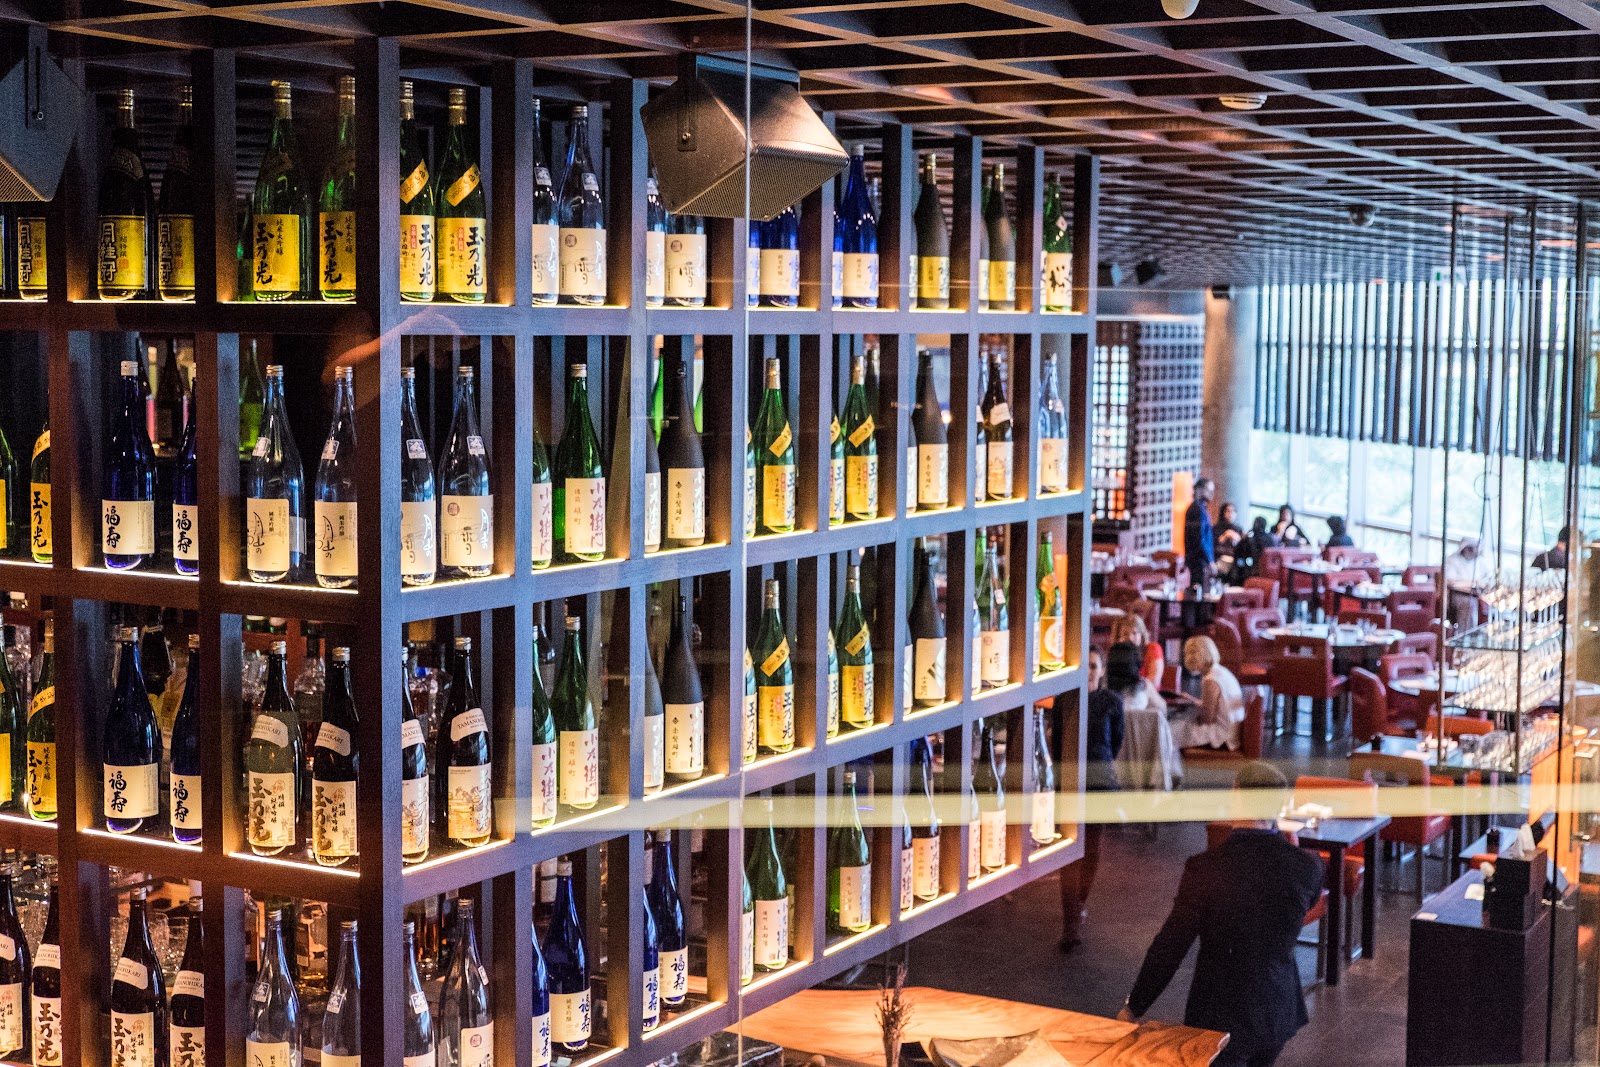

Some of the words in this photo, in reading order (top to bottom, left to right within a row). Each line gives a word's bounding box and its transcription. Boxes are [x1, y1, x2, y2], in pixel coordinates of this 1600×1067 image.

[256, 222, 275, 285] 玉乃光
[324, 220, 343, 285] 玉乃光
[419, 224, 434, 286] 玉乃光
[466, 226, 484, 287] 玉乃光
[33, 491, 49, 547] 玉乃光
[28, 749, 43, 806] 玉乃光
[109, 770, 128, 812] 福寿
[173, 780, 189, 823] 福寿
[252, 777, 272, 842] 玉乃光
[315, 785, 333, 851] 玉乃光
[671, 954, 685, 991] 福寿
[38, 1003, 61, 1061] 玉乃光
